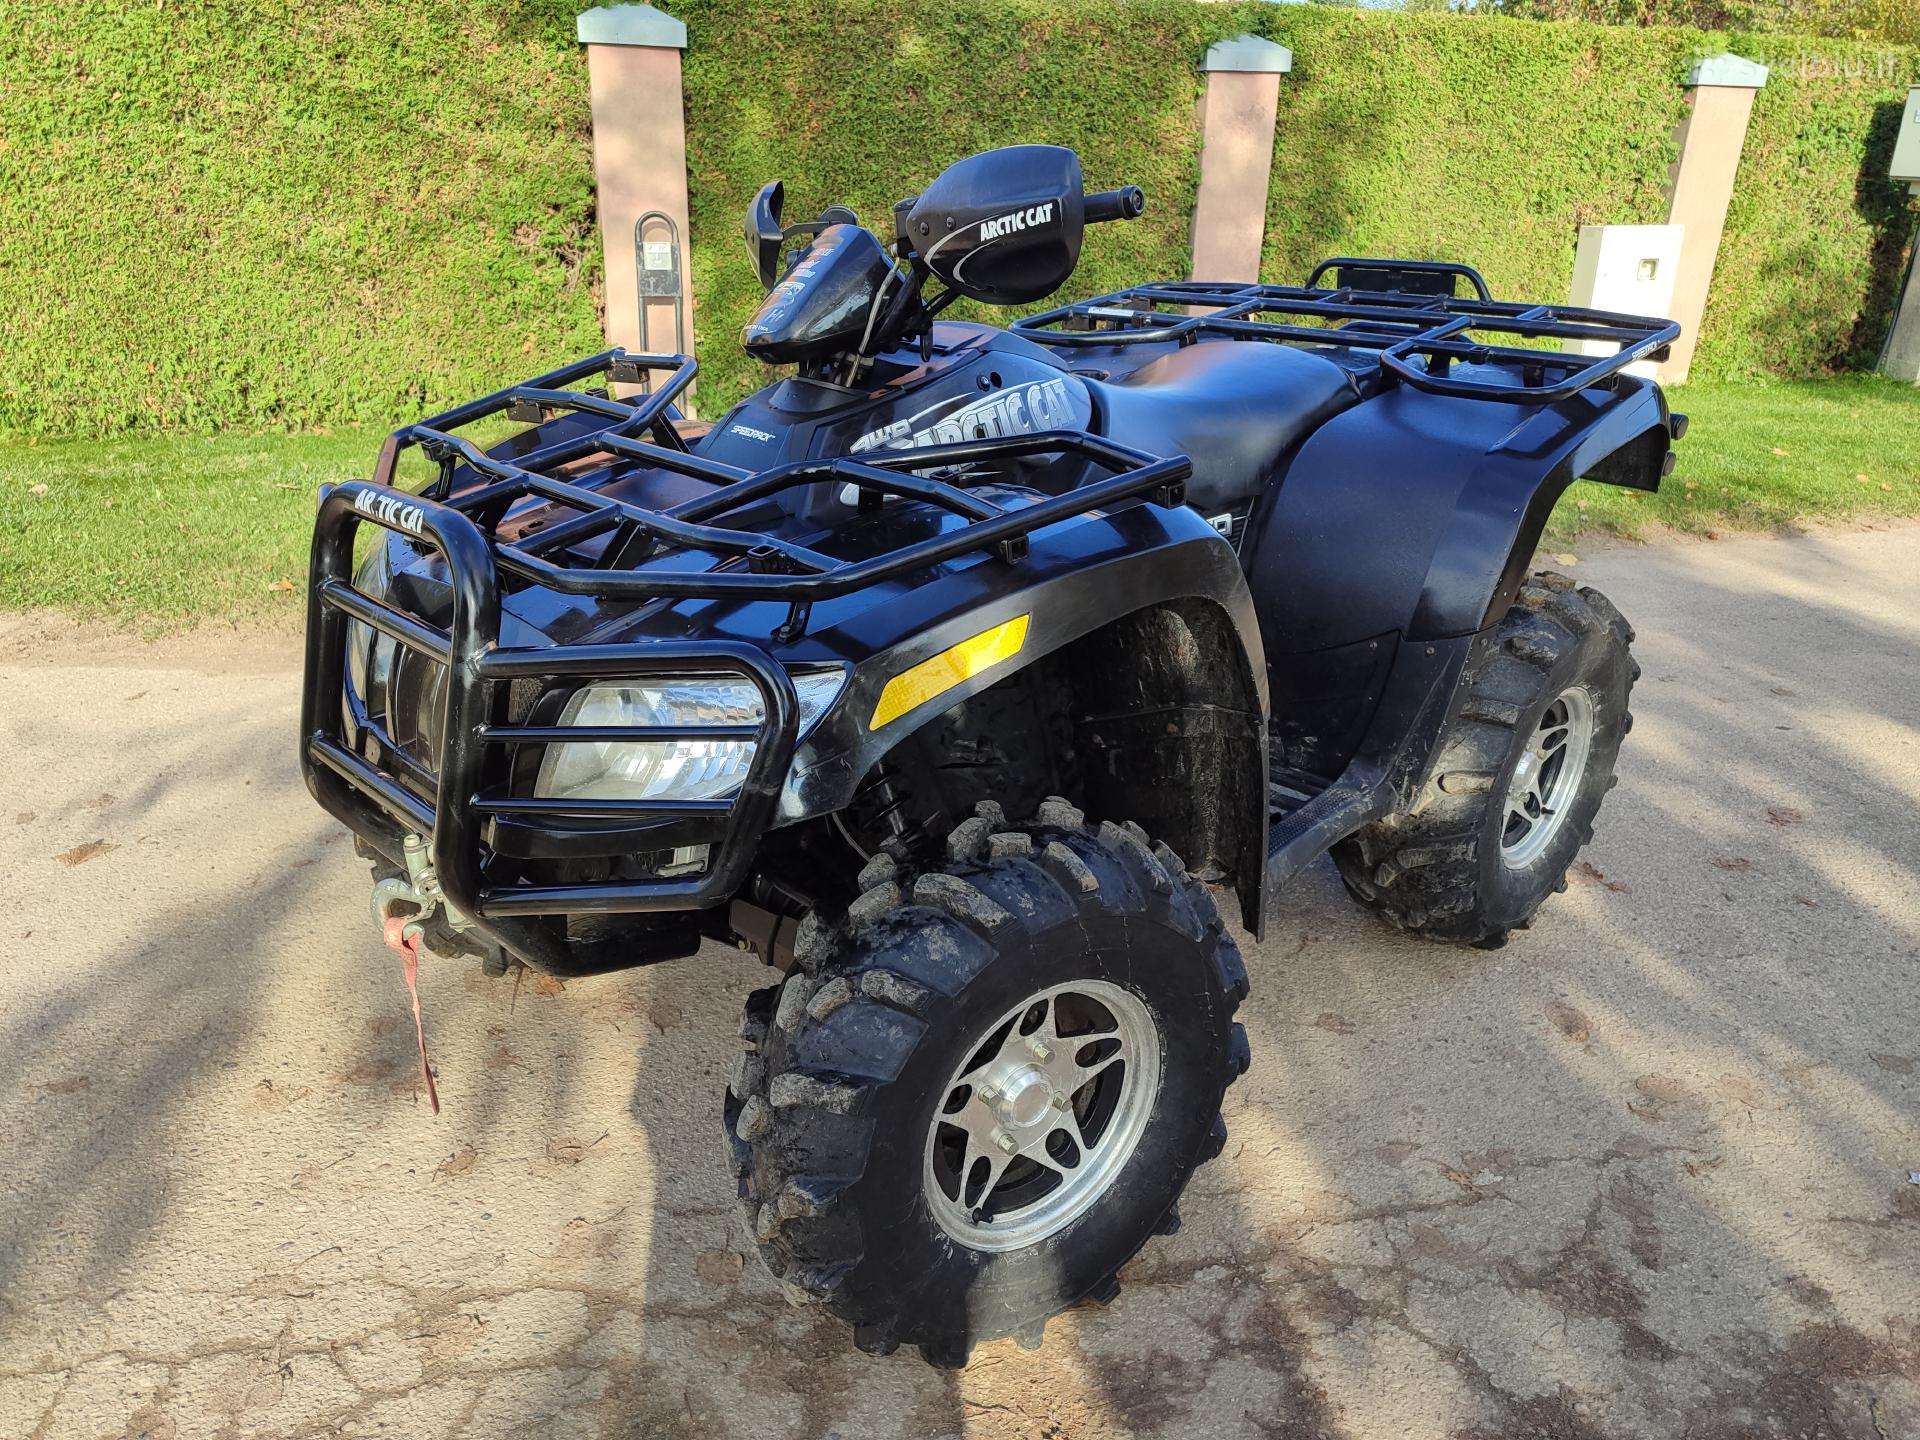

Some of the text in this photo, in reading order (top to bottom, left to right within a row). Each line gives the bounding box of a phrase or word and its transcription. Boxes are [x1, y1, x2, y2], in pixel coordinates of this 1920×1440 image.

[980, 203, 1053, 242] ARCTIC CAT
[1027, 377, 1078, 432] CAT
[355, 489, 403, 525] ARTIC
